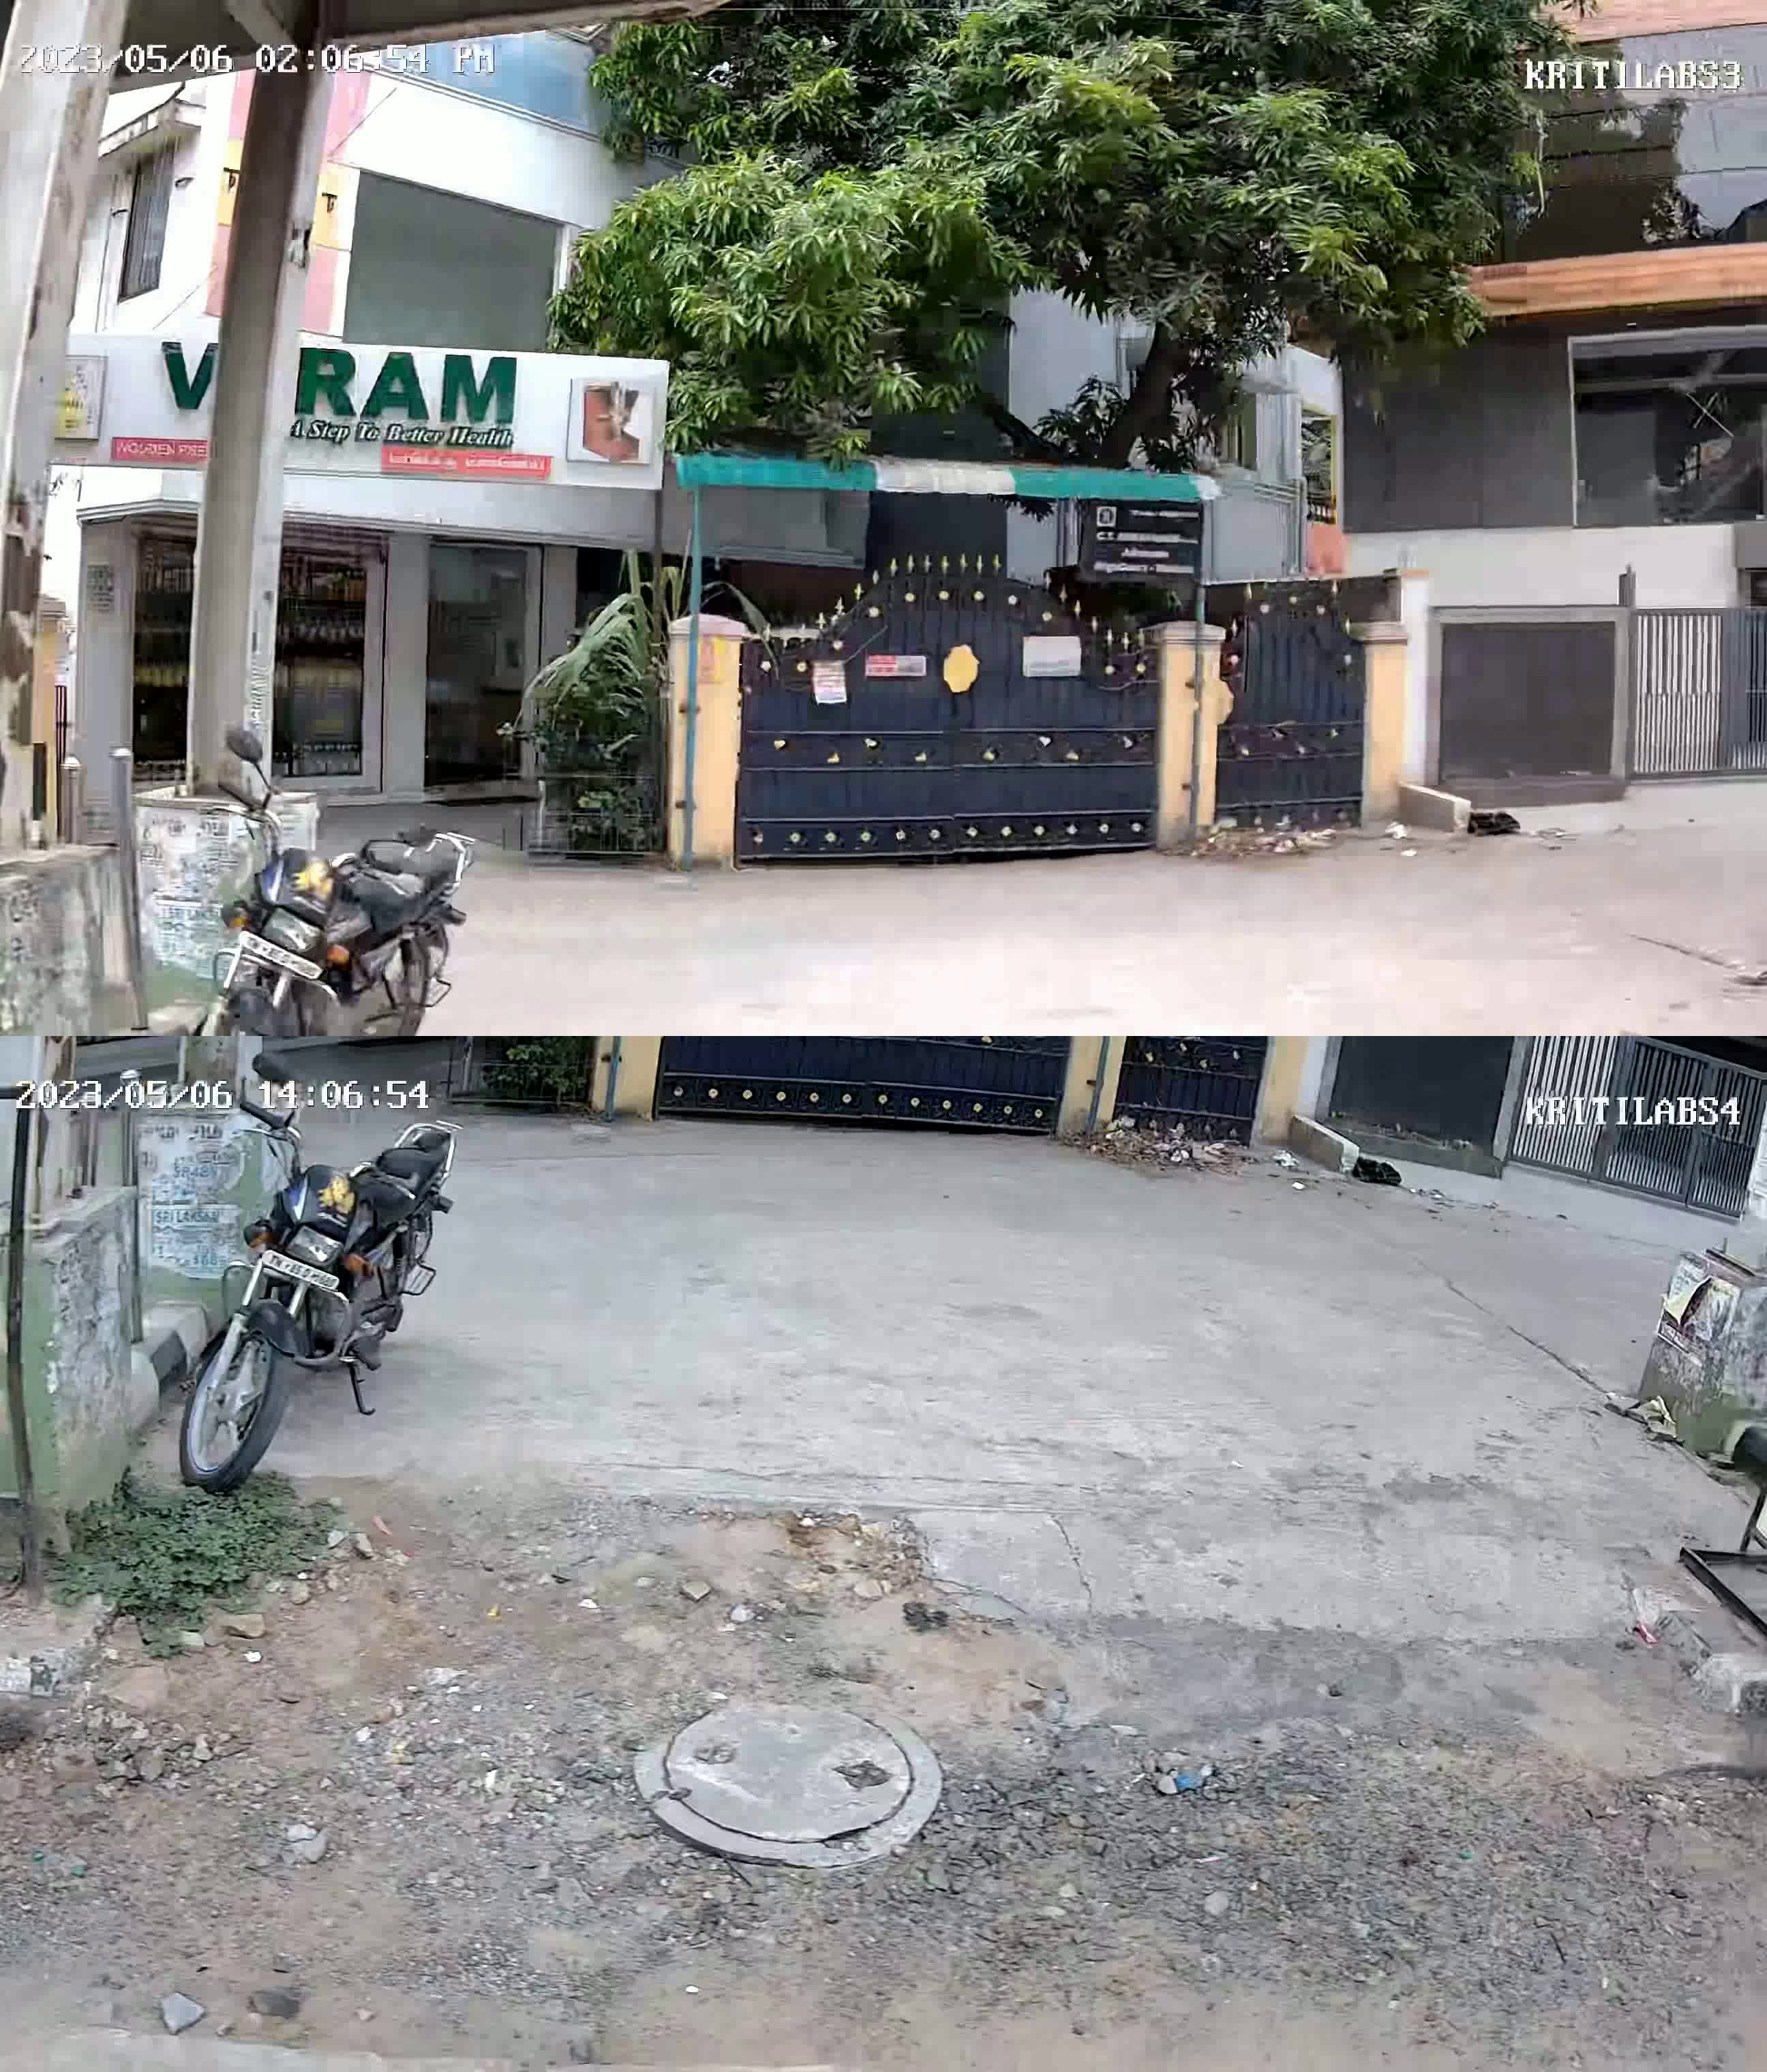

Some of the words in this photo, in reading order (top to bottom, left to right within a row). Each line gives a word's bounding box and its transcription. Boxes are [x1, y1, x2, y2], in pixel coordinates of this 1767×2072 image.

[161, 341, 517, 424] VRAM
[307, 420, 351, 444] Step
[355, 421, 381, 442] To
[382, 423, 444, 446] Better
[446, 426, 515, 449] Health
